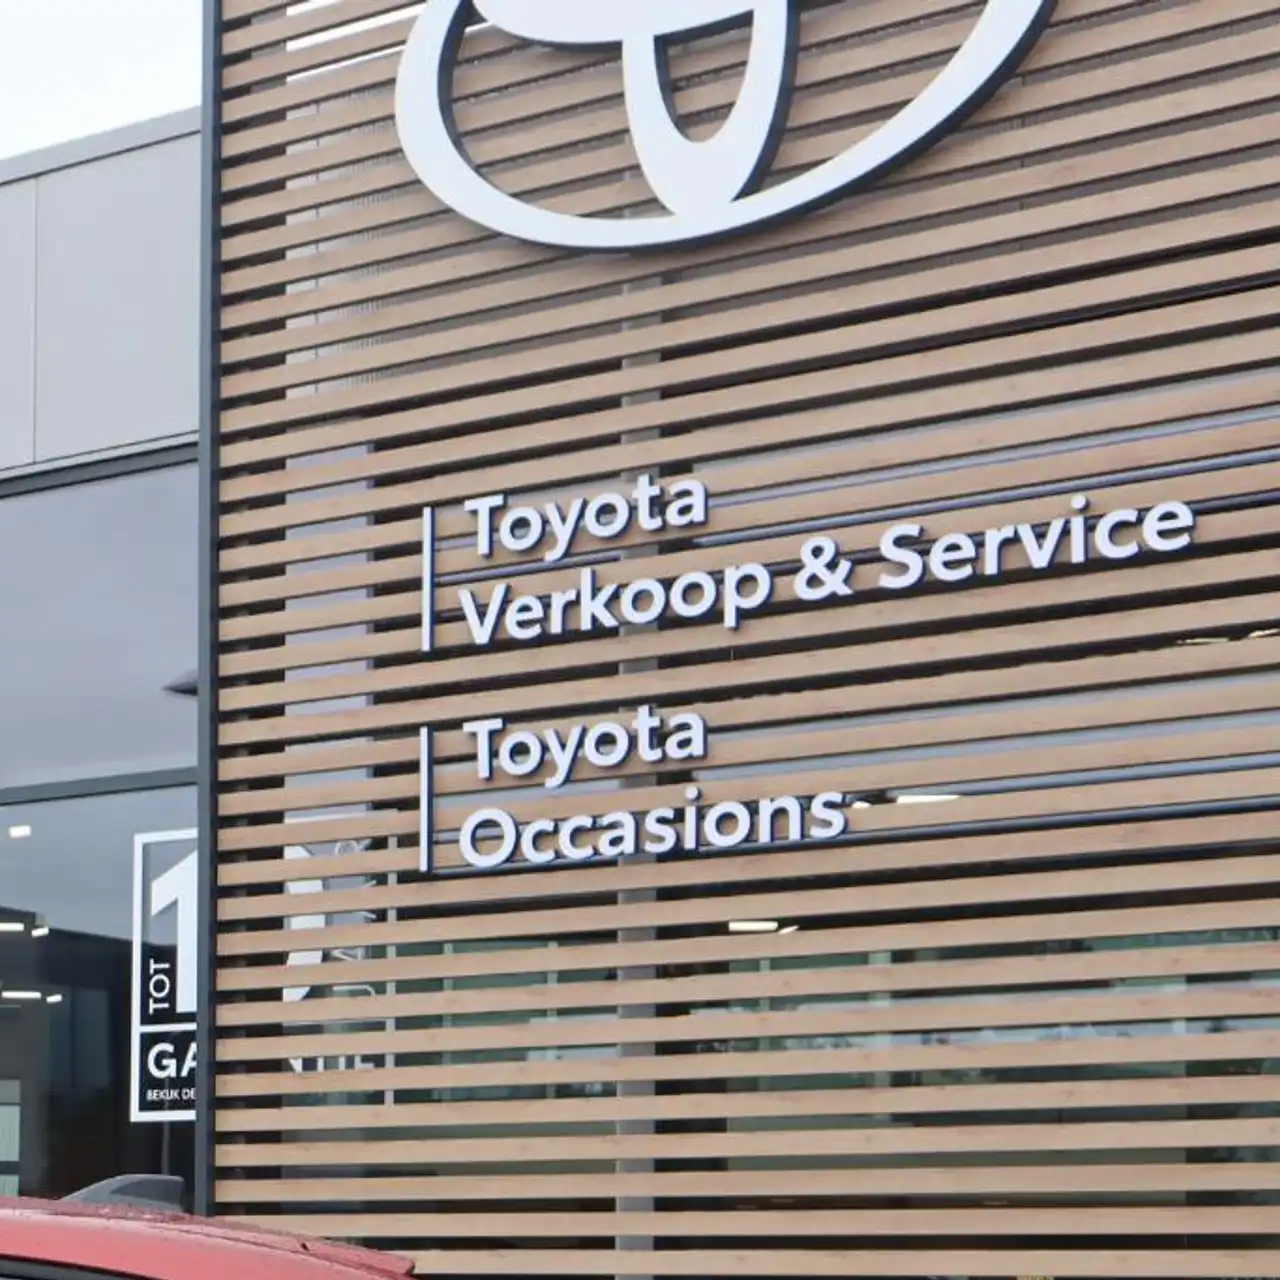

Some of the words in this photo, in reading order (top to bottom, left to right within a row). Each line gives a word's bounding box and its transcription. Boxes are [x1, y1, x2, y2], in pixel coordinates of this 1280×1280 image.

[465, 473, 706, 562] Toyota
[458, 561, 771, 646] Verkoop
[793, 536, 852, 601] &
[878, 493, 1194, 590] Service
[463, 704, 705, 789] Toyota
[458, 786, 844, 868] Occasions
[149, 958, 171, 1015] TOT
